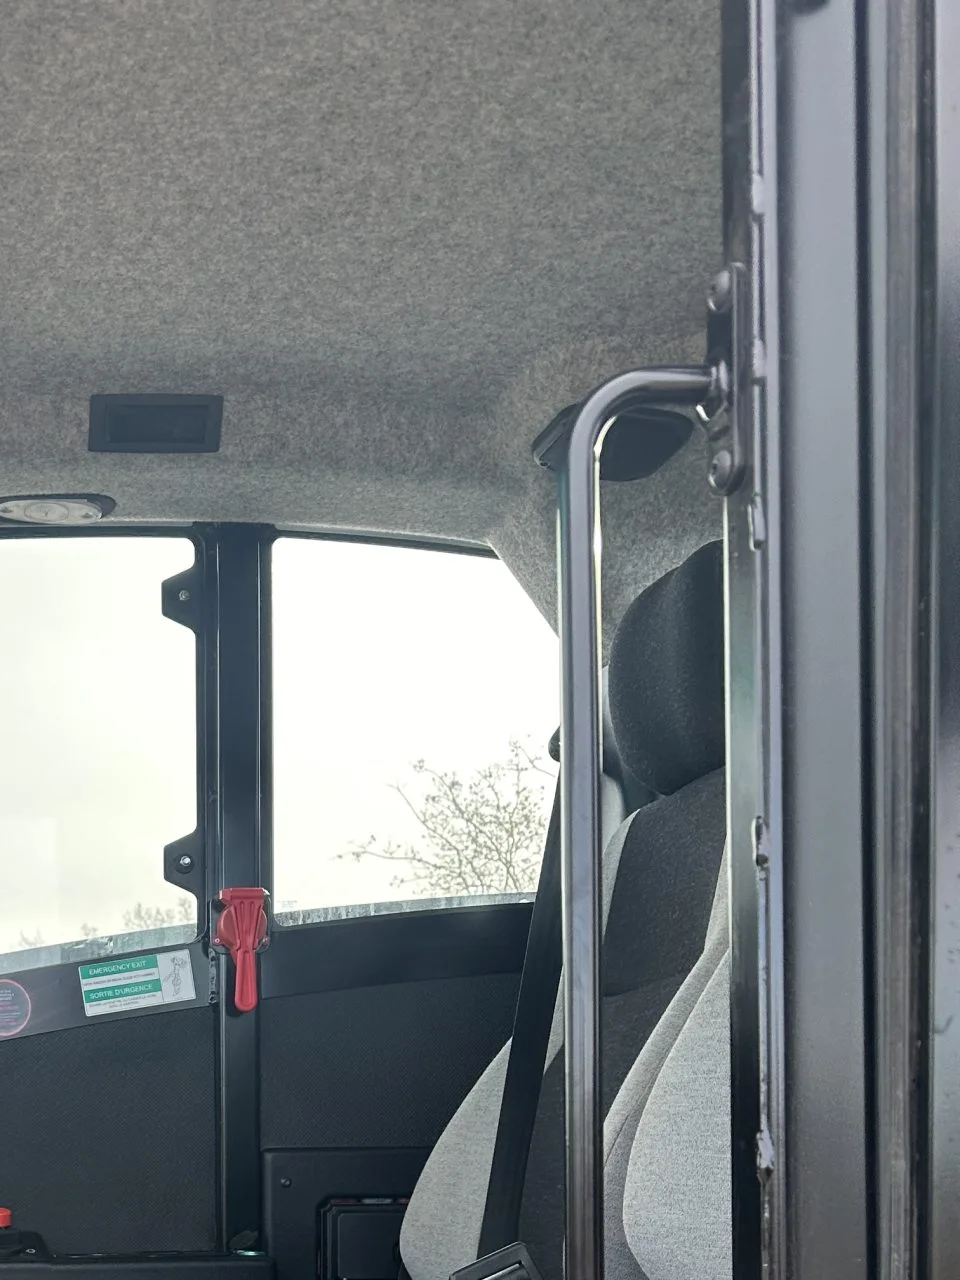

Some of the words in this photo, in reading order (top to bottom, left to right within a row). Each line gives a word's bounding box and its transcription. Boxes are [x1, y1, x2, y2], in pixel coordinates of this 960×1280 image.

[89, 964, 130, 975] EMERGENCY
[132, 960, 146, 968] EXIT
[89, 989, 114, 1000] SORTIE
[115, 984, 153, 996] D'URGENCE
